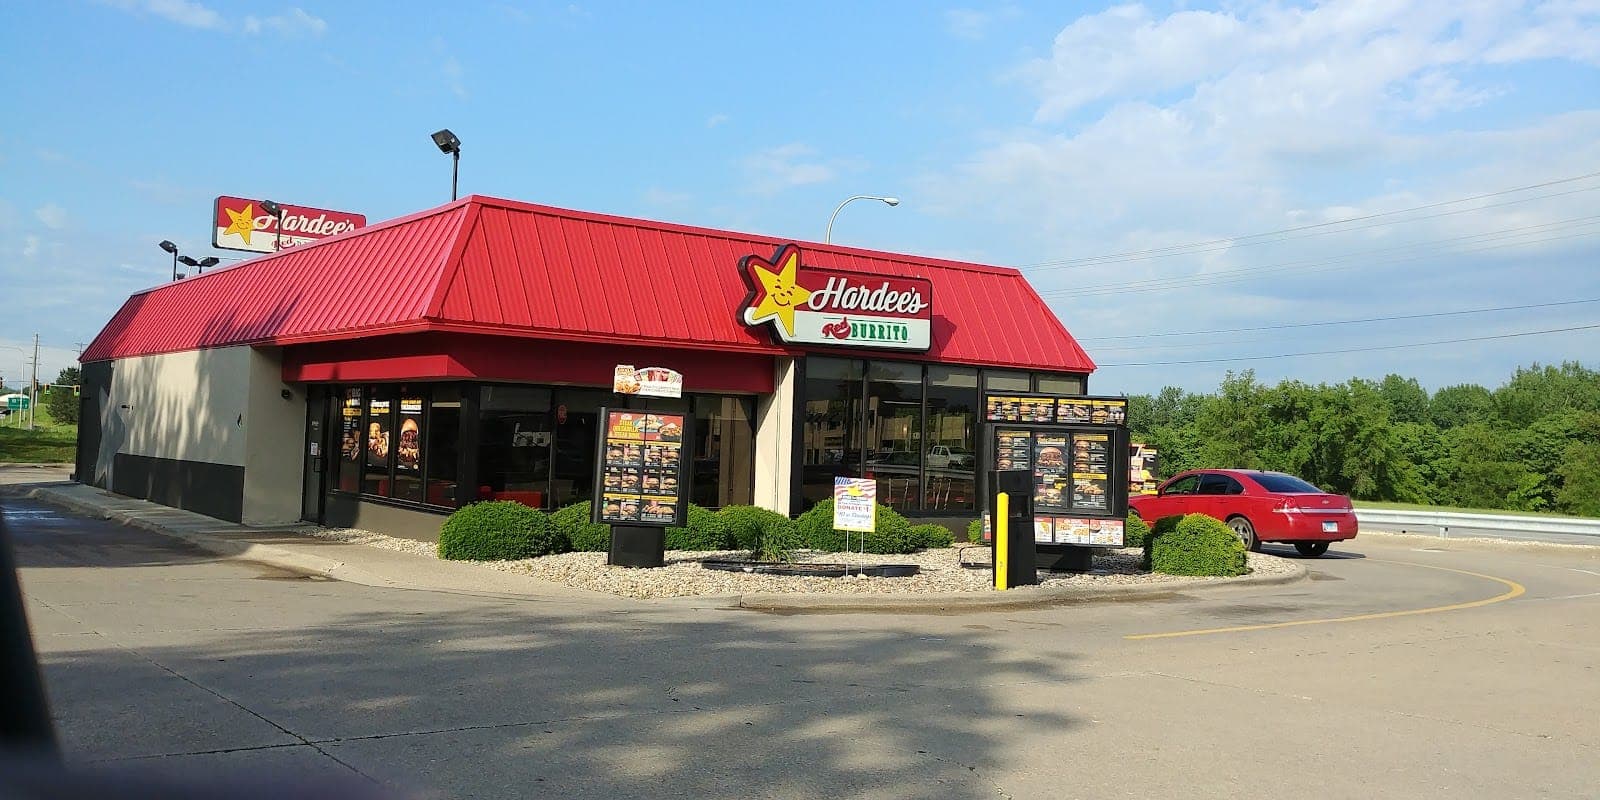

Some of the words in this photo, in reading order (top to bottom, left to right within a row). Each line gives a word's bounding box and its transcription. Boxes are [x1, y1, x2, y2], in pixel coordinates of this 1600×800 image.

[253, 209, 355, 235] Hardee's
[808, 276, 928, 314] Hardee's
[822, 316, 851, 340] Red
[851, 322, 909, 341] BURRITO
